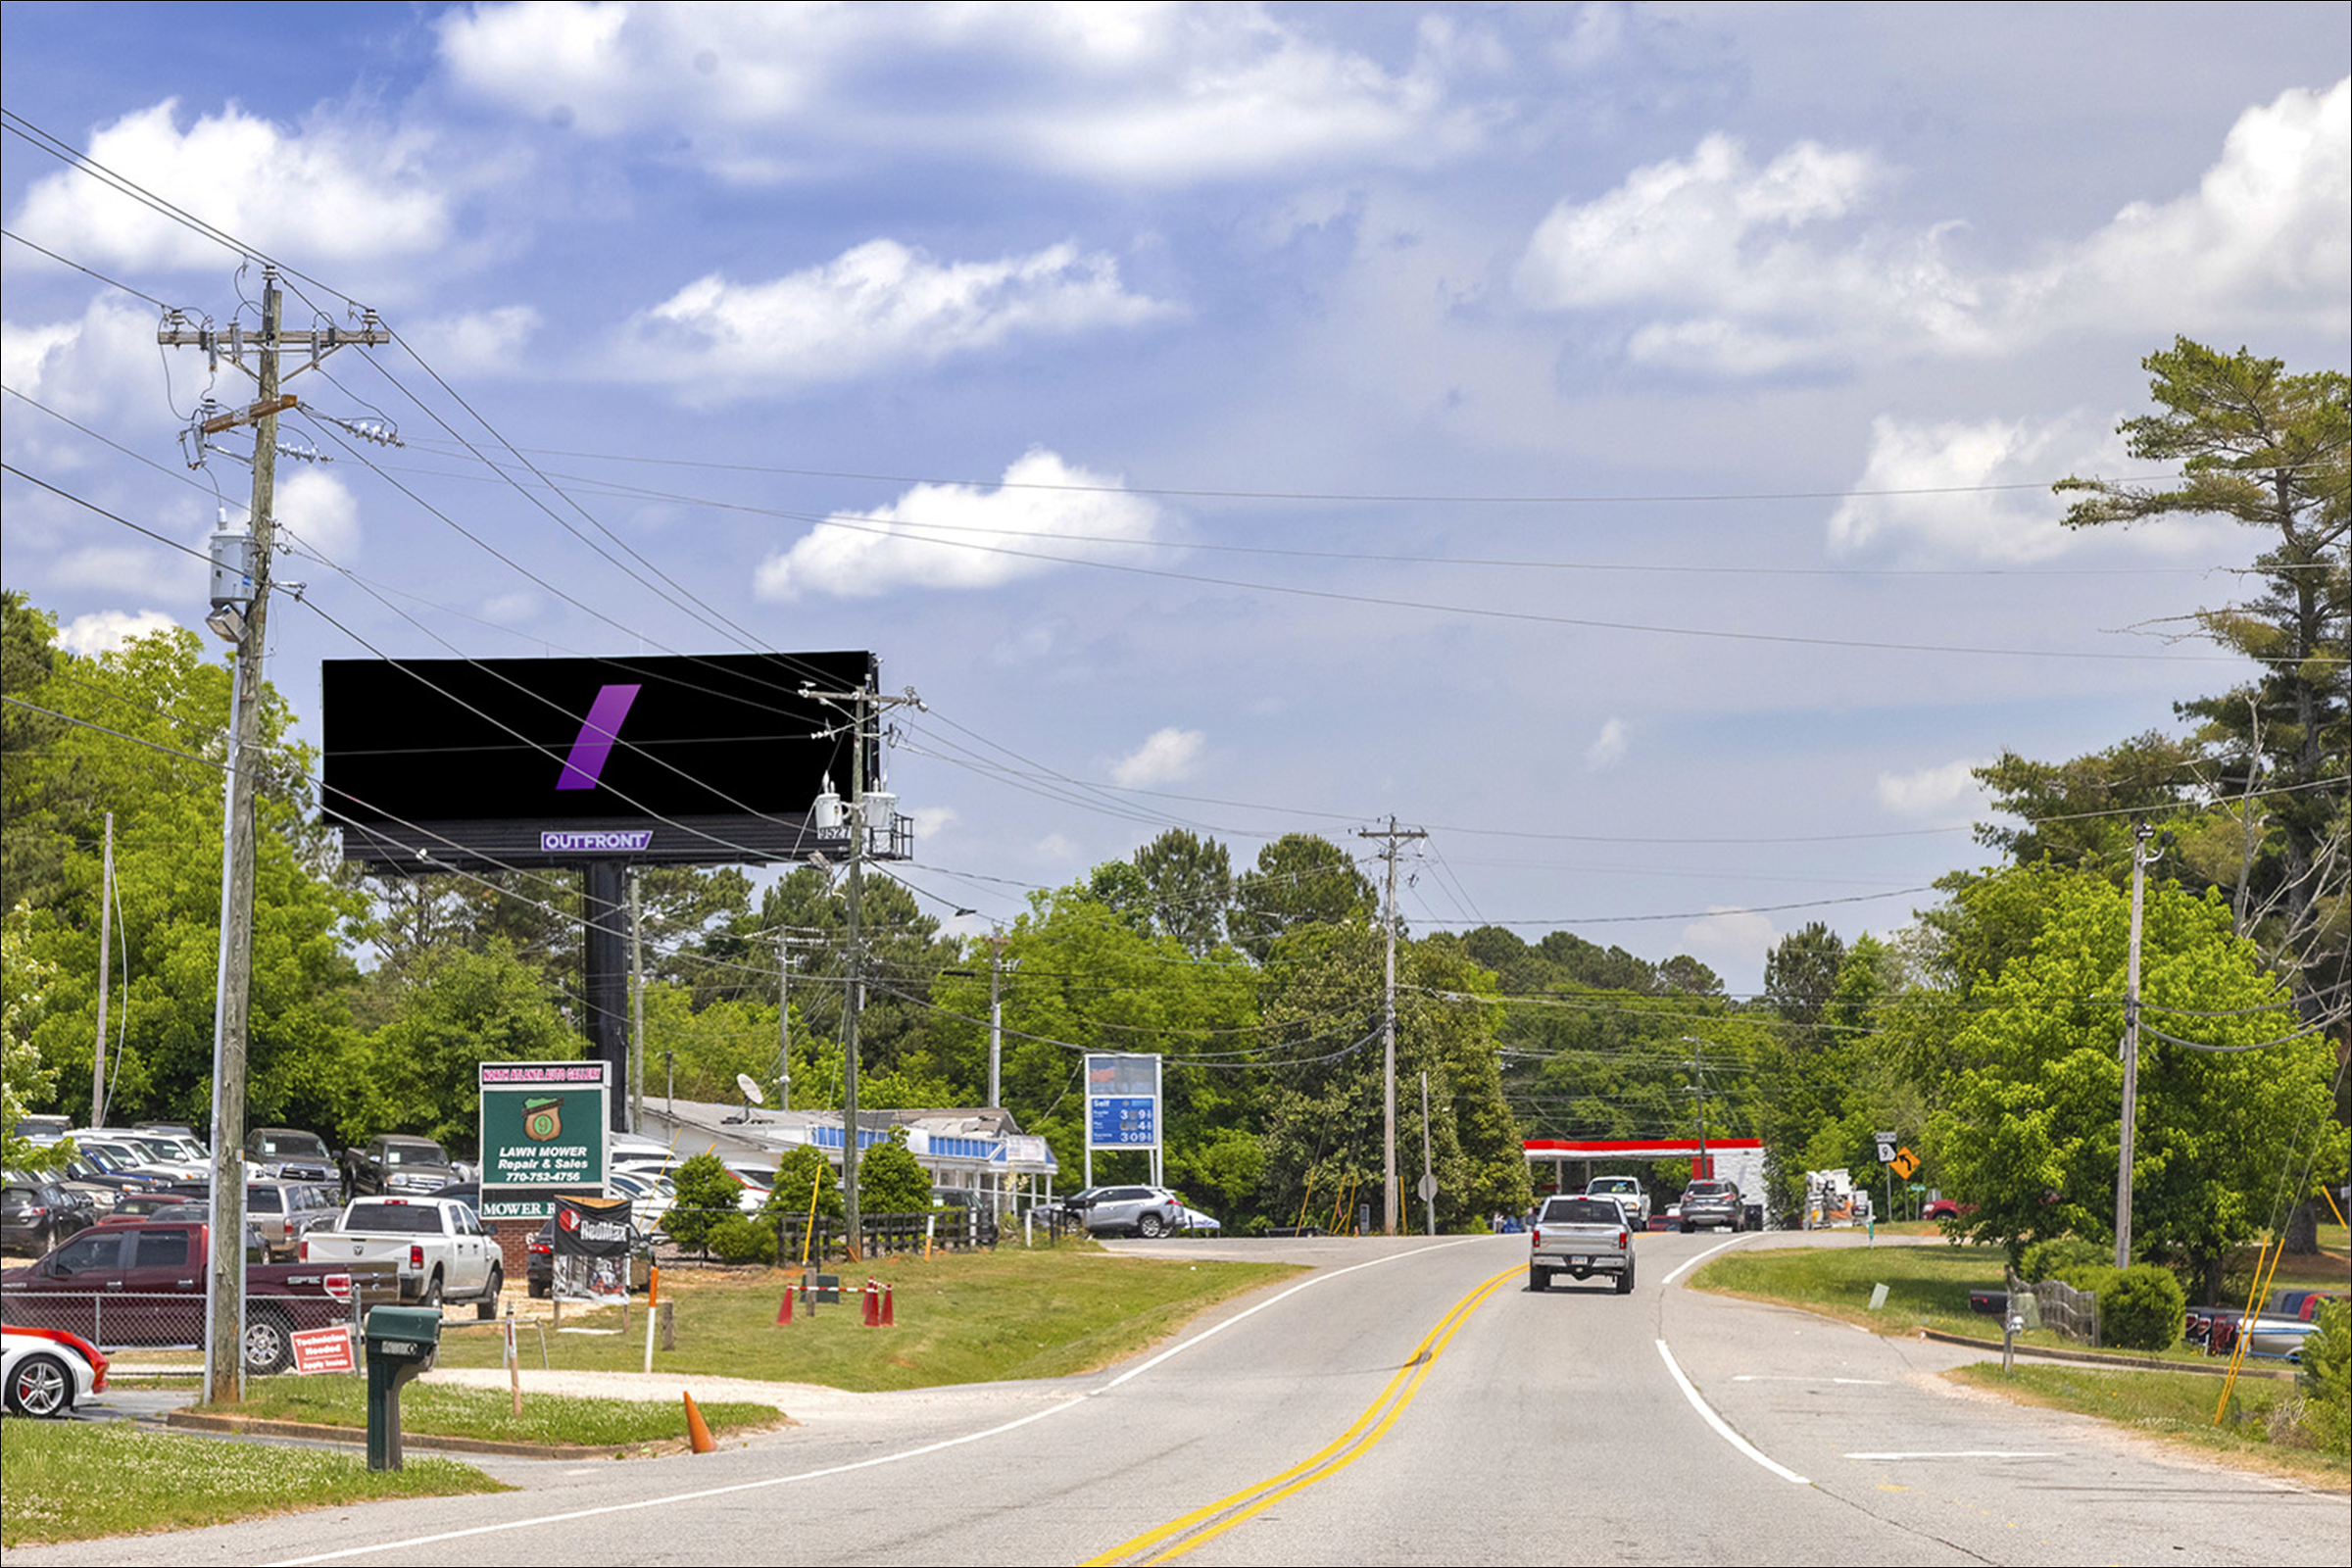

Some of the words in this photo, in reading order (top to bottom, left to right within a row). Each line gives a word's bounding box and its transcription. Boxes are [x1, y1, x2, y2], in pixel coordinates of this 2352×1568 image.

[819, 827, 850, 840] 9527
[546, 834, 645, 849] OUTFRONT
[483, 1068, 510, 1082] NORTH
[511, 1068, 544, 1081] ATLANTA
[545, 1068, 565, 1081] AUTO
[566, 1067, 602, 1080] GALLERY
[538, 1117, 549, 1133] 9
[499, 1147, 536, 1157] LAWN
[539, 1147, 588, 1157] MOWER
[1883, 1147, 1888, 1157] 9
[498, 1159, 539, 1171] Repair
[541, 1159, 552, 1169] &
[555, 1159, 588, 1169] Sales
[506, 1172, 581, 1182] 770-752-4756
[483, 1202, 542, 1216] MOWER
[580, 1220, 627, 1241] RedMax
[295, 1334, 347, 1347] Technician
[305, 1344, 341, 1355] Needed
